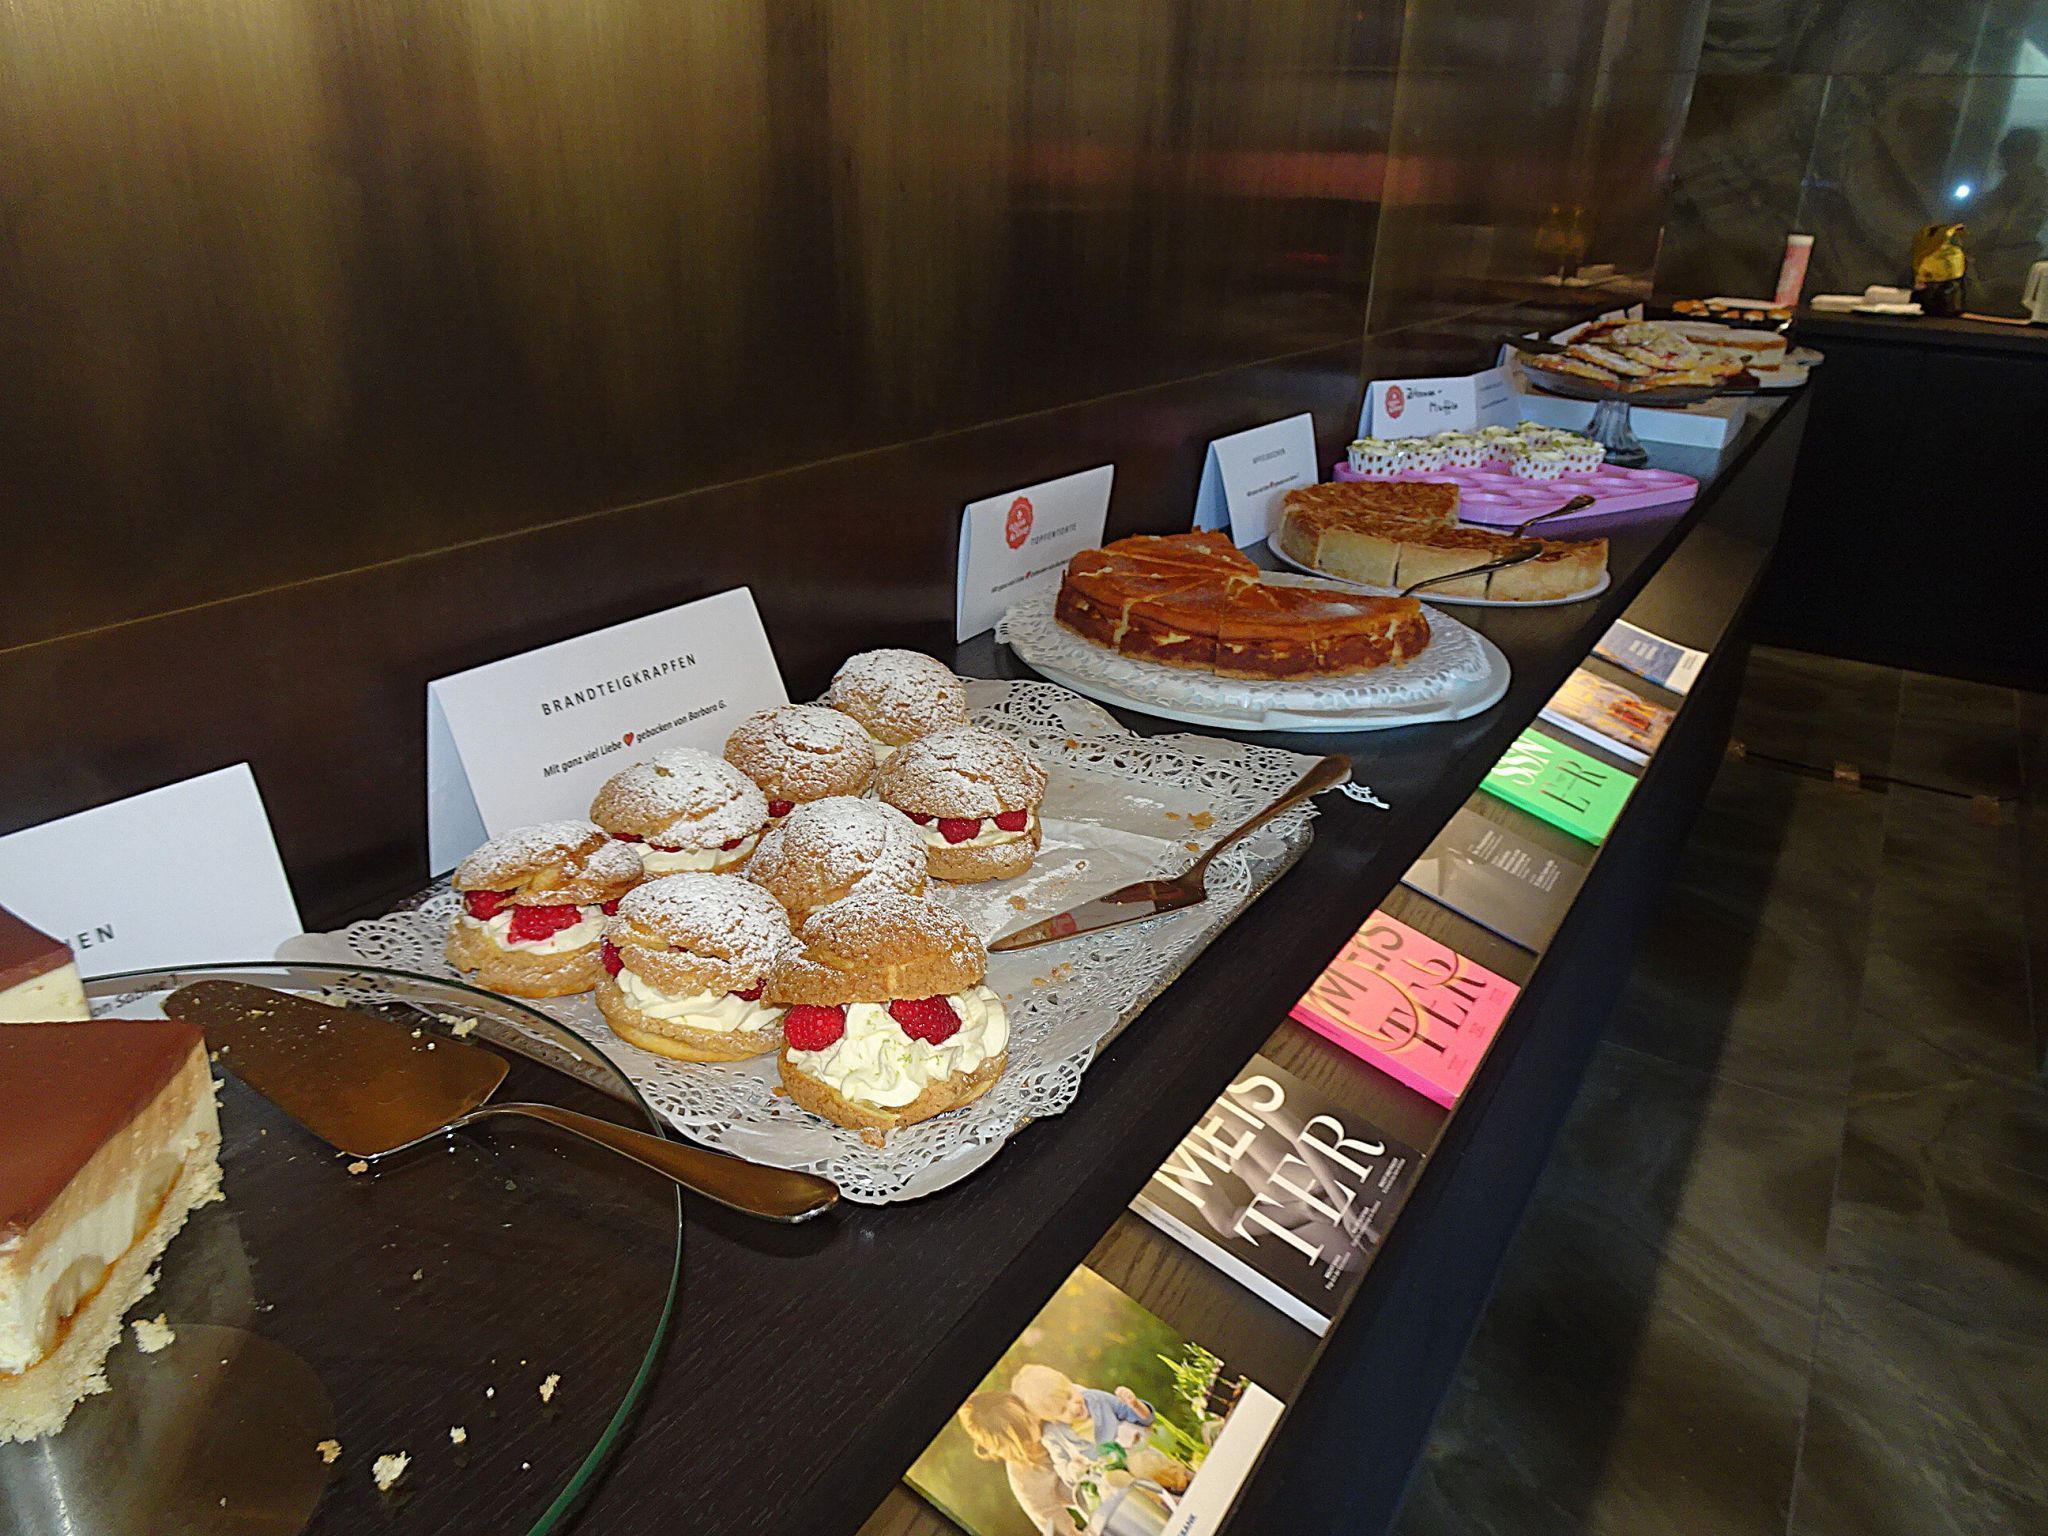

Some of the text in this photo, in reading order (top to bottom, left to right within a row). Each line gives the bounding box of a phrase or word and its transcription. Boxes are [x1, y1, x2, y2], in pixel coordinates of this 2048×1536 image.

[541, 653, 697, 716] BRANDTEIGKRAPFEN
[543, 766, 561, 778] Mit
[561, 757, 582, 773] ganz
[583, 747, 600, 762] viel
[600, 739, 622, 756] Liebe
[636, 720, 673, 744] gebacken
[673, 715, 688, 728] von
[688, 704, 718, 722] Barbara
[1152, 1075, 1286, 1208] MEIS
[1233, 1114, 1386, 1267] TER
